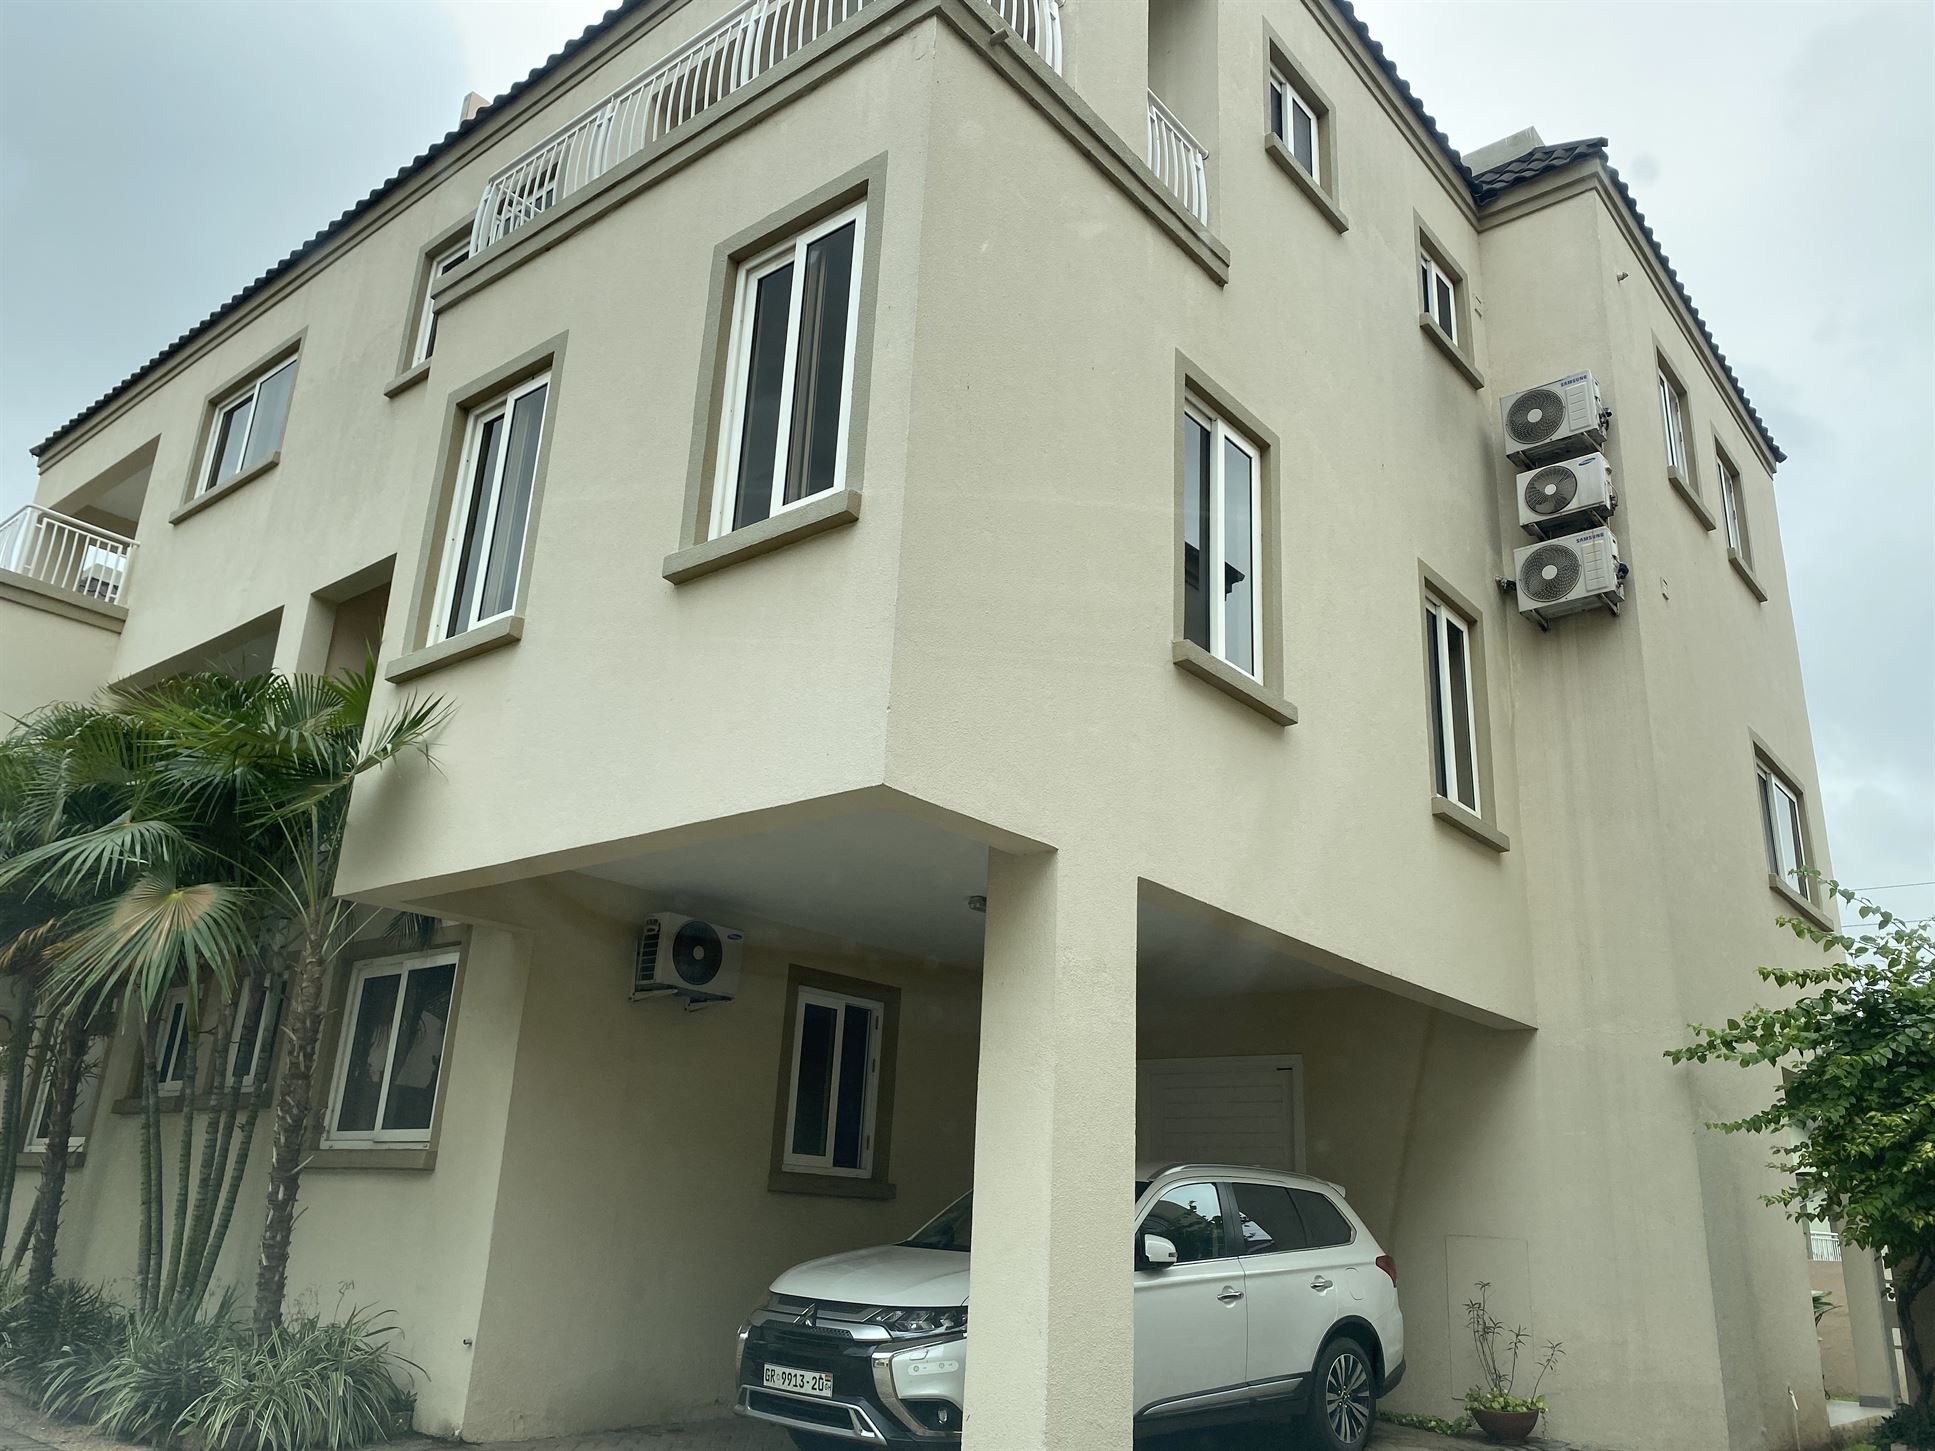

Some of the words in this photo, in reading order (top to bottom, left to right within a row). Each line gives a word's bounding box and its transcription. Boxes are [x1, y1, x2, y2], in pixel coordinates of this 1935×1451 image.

[1560, 374, 1587, 387] SAMSUNG
[1576, 532, 1604, 543] SAMSUNG
[765, 1368, 775, 1383] GR
